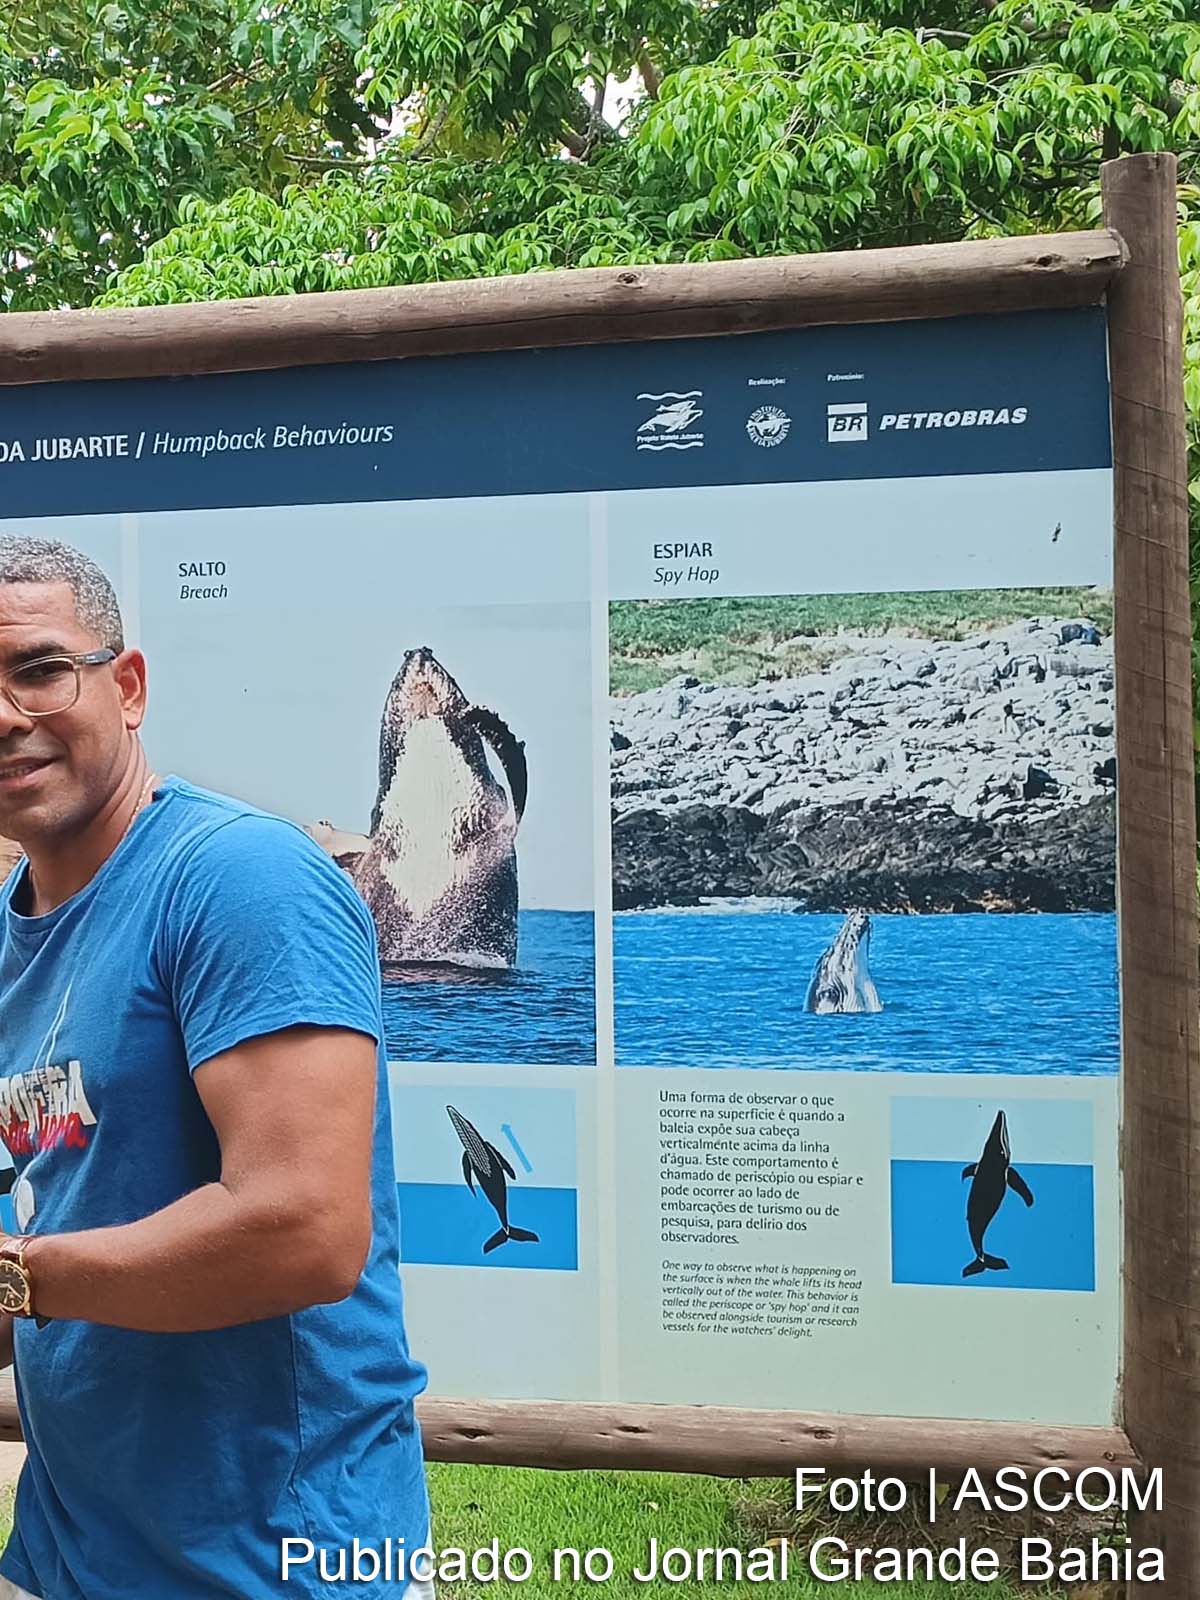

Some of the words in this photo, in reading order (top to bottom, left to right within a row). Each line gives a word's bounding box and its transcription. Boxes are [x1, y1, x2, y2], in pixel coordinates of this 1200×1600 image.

[831, 417, 863, 433] BR
[879, 407, 1028, 431] PETROBRAS
[32, 435, 128, 461] JUBARTE
[135, 432, 146, 459] /
[153, 428, 266, 457] Humpback
[273, 422, 394, 449] Behaviours
[654, 542, 712, 559] ESPIAR
[178, 561, 226, 577] SALTO
[654, 567, 683, 586] Spy
[688, 566, 719, 584] Hop
[180, 584, 228, 599] Breach
[660, 1091, 686, 1103] Uma
[691, 1091, 725, 1104] forma
[729, 1092, 743, 1104] de
[747, 1093, 797, 1105] observar
[801, 1096, 808, 1105] o
[812, 1095, 834, 1109] que
[660, 1109, 696, 1119] ocorre
[700, 1110, 714, 1119] na
[778, 1109, 785, 1121] é
[789, 1111, 834, 1123] quando
[838, 1112, 845, 1122] a
[660, 1122, 694, 1134] baleia
[697, 1123, 732, 1138] expõe
[736, 1126, 755, 1136] sua
[759, 1125, 800, 1139] cabeça
[743, 1141, 778, 1152] acima
[782, 1140, 796, 1152] da
[800, 1141, 829, 1153] linha
[706, 1155, 729, 1166] Este
[733, 1157, 828, 1169] comportamento
[832, 1157, 839, 1169] é
[660, 1168, 714, 1181] chamado
[717, 1170, 731, 1182] de
[735, 1171, 795, 1185] periscópio
[799, 1174, 813, 1184] ou
[817, 1173, 853, 1187] espiar
[856, 1176, 864, 1186] e
[661, 1184, 689, 1198] pode
[693, 1187, 734, 1197] ocorrer
[738, 1188, 753, 1198] ao
[756, 1187, 781, 1199] lado
[785, 1188, 800, 1199] de
[661, 1199, 736, 1214] embarcações
[739, 1202, 754, 1213] de
[757, 1202, 802, 1215] turismo
[806, 1205, 821, 1216] ou
[825, 1205, 840, 1216] de
[661, 1215, 713, 1229] pesquisa,
[717, 1219, 742, 1230] para
[786, 1219, 807, 1231] dos
[661, 1231, 739, 1245] observadores.
[662, 1260, 680, 1270] One
[683, 1263, 702, 1273] way
[704, 1262, 714, 1271] to
[716, 1262, 752, 1273] observe
[755, 1264, 778, 1274] what
[781, 1264, 789, 1274] is
[791, 1264, 841, 1277] happening
[843, 1268, 856, 1276] on
[663, 1273, 677, 1282] the
[680, 1274, 714, 1284] surface
[716, 1275, 724, 1284] is
[726, 1276, 752, 1285] when
[755, 1276, 770, 1286] the
[803, 1278, 821, 1288] lifts
[824, 1279, 835, 1288] its
[838, 1280, 862, 1290] head
[662, 1285, 704, 1296] vertically
[706, 1287, 722, 1296] out
[725, 1287, 735, 1296] of
[737, 1288, 752, 1297] the
[787, 1289, 805, 1300] This
[807, 1291, 848, 1301] behavior
[851, 1292, 858, 1302] is
[662, 1297, 689, 1307] called
[692, 1298, 707, 1308] the
[709, 1300, 753, 1312] periscope
[755, 1301, 765, 1310] or
[811, 1304, 830, 1313] and
[832, 1304, 839, 1314] it
[842, 1305, 860, 1314] can
[663, 1310, 674, 1320] be
[676, 1311, 717, 1321] observed
[719, 1313, 764, 1324] alongside
[767, 1315, 802, 1324] tourism
[805, 1317, 815, 1325] or
[818, 1316, 857, 1327] research
[662, 1322, 695, 1332] vessels
[697, 1323, 711, 1333] for
[713, 1324, 729, 1334] the
